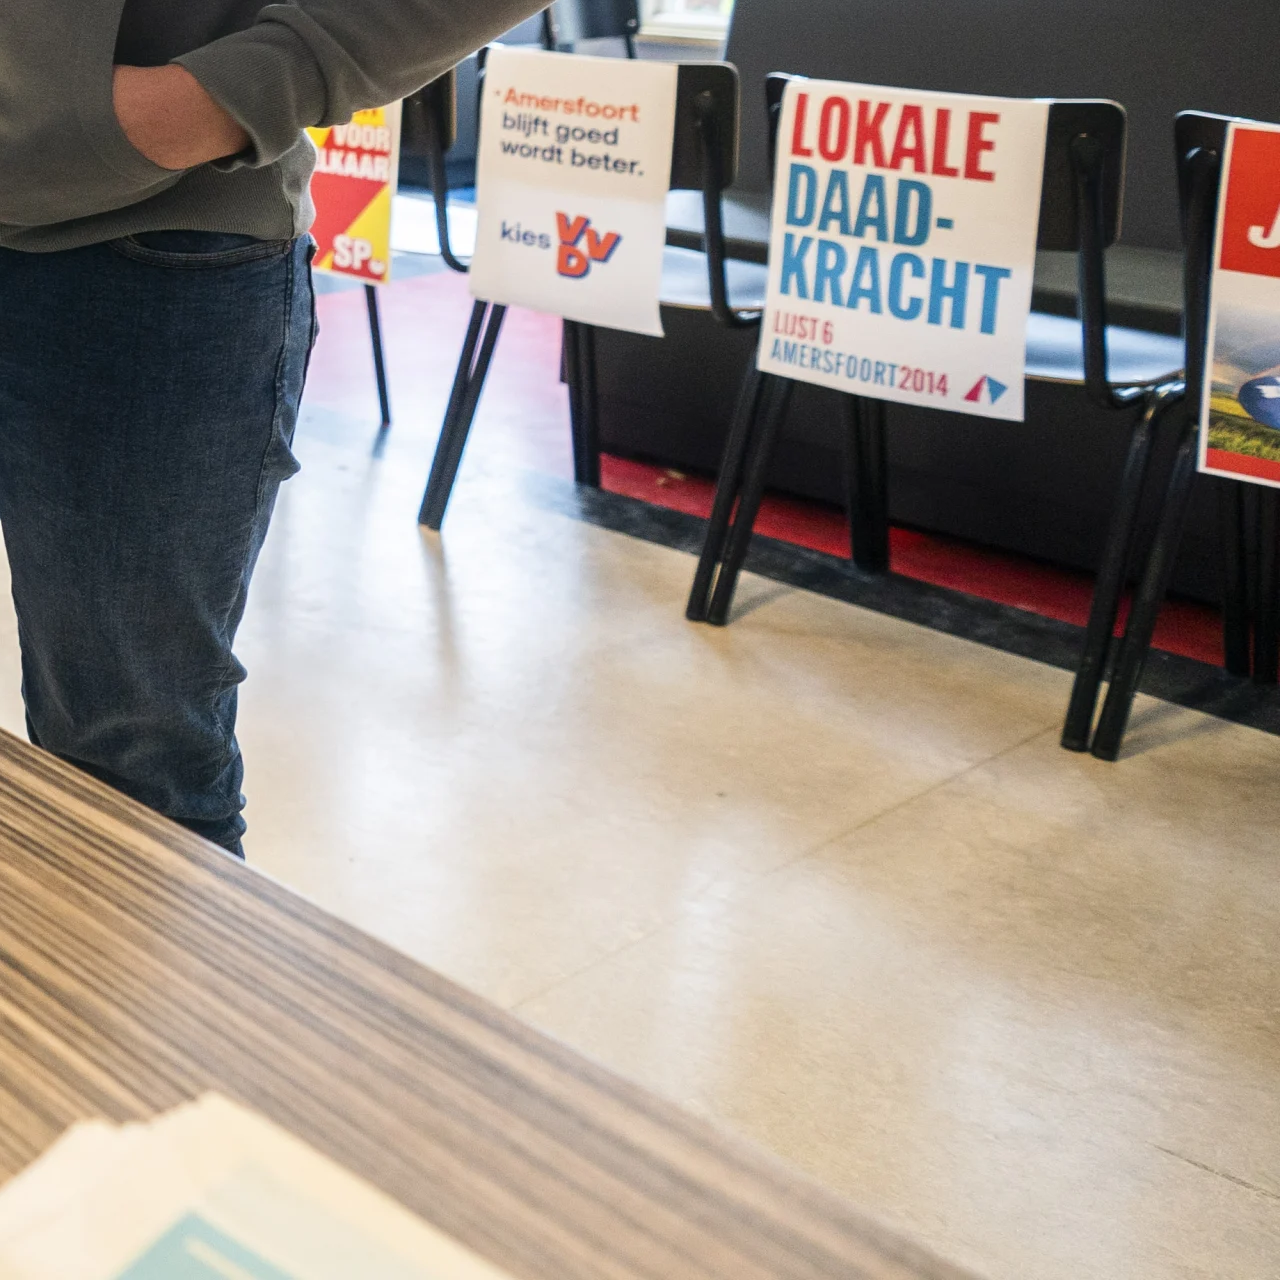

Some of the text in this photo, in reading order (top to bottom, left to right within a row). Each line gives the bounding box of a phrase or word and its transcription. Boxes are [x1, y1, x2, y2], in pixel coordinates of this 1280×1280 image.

[504, 88, 640, 122] Amersfoort
[333, 125, 391, 153] VOOR
[502, 113, 619, 146] blijft goed
[790, 92, 1001, 183] LOKALE
[501, 140, 644, 176] wordt beter.
[785, 163, 954, 246] DAAD-
[501, 221, 551, 249] kies
[779, 233, 1012, 335] KRACHT
[773, 311, 833, 344] LIJST 6
[771, 339, 949, 397] AMERSFOORT2014
